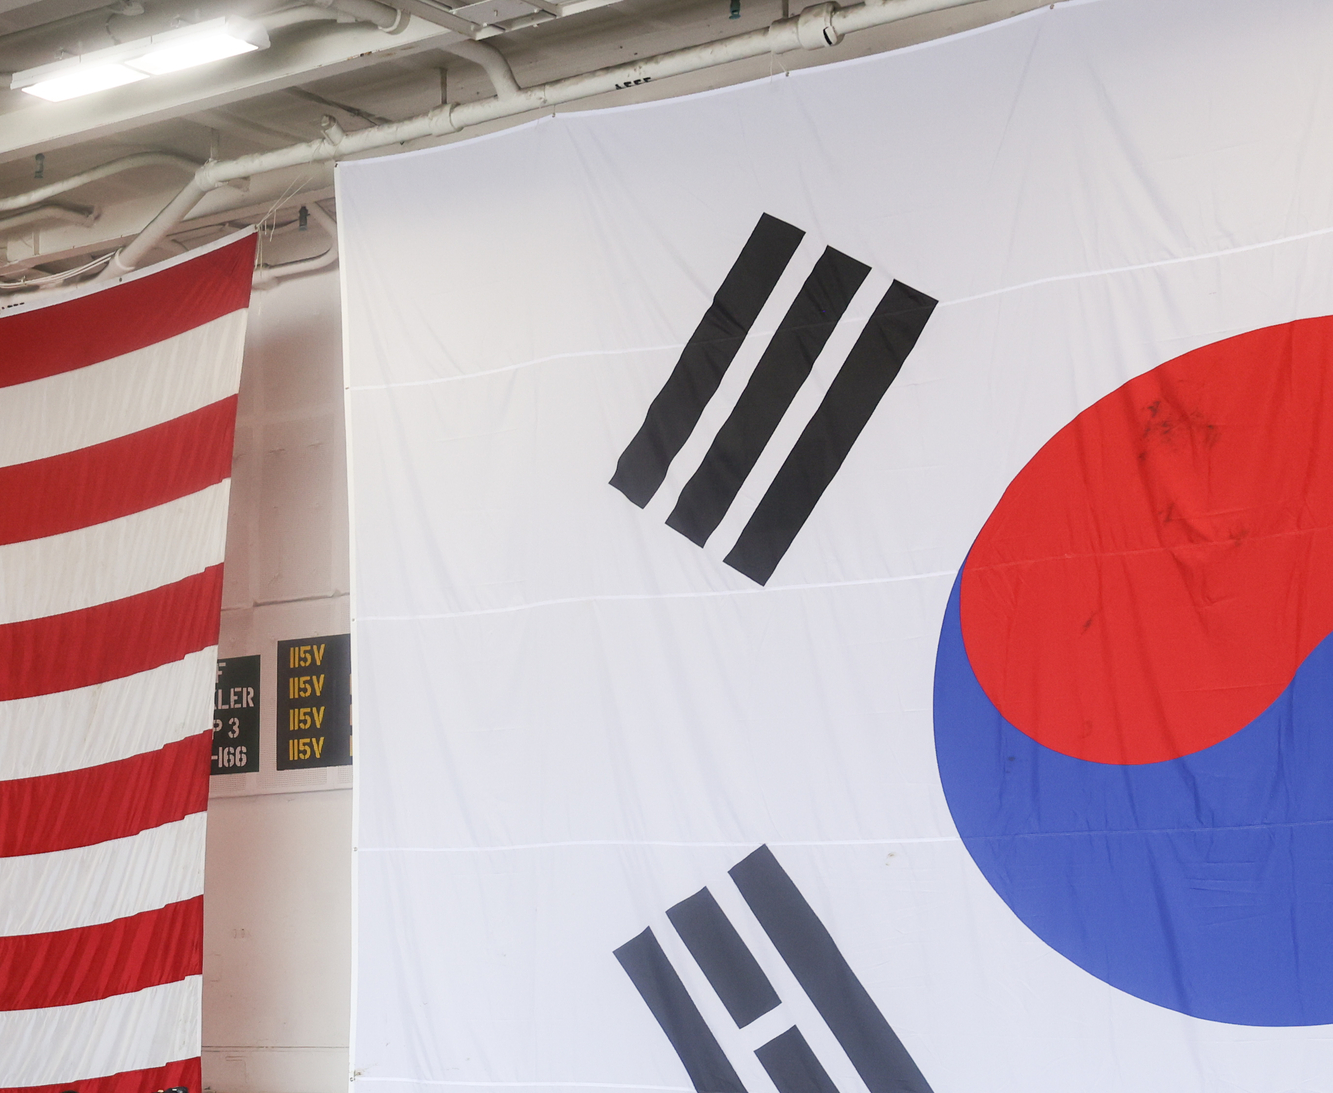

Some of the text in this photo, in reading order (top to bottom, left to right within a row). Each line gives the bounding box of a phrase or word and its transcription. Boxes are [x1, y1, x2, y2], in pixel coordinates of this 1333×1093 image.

[289, 644, 325, 668] 115V
[289, 674, 325, 699] 115V
[228, 718, 240, 738] 3
[289, 706, 325, 730] 115V
[289, 737, 325, 760] 115V
